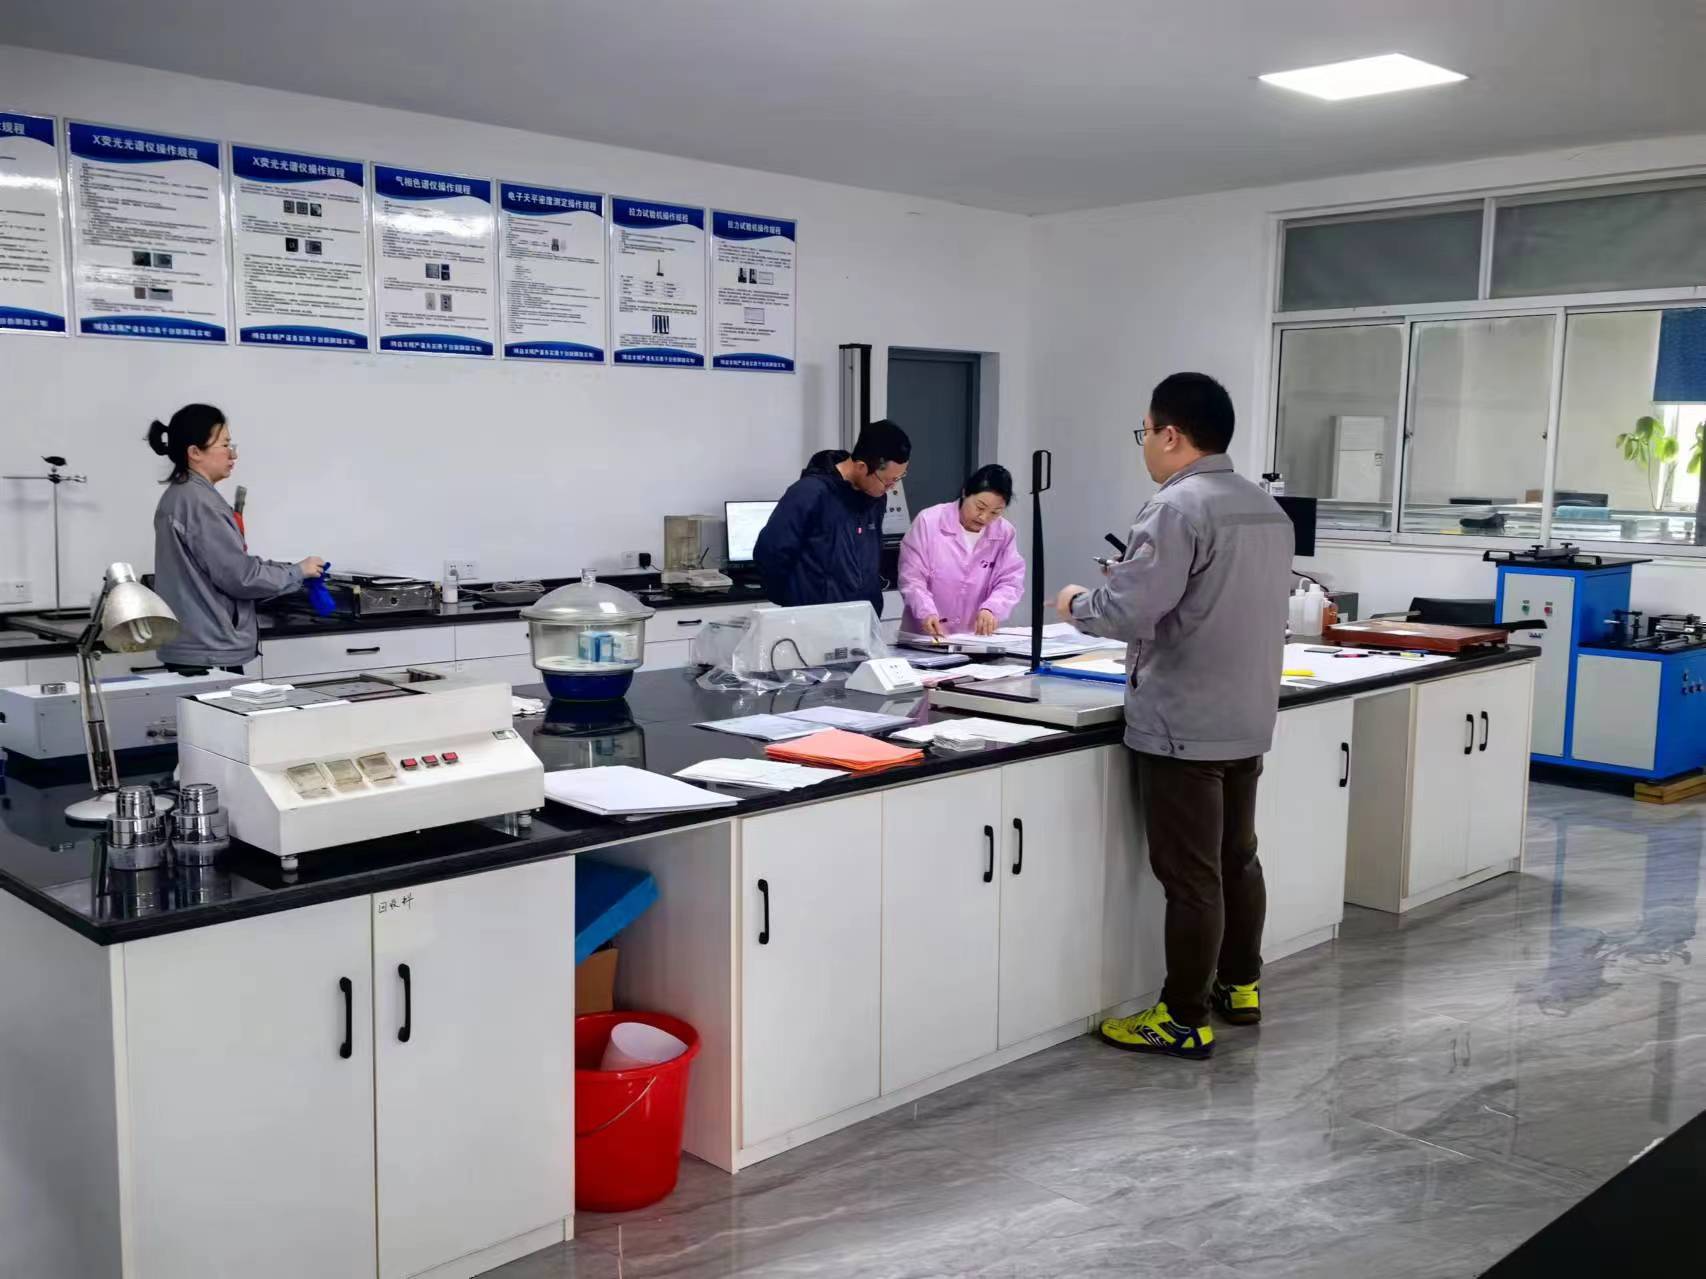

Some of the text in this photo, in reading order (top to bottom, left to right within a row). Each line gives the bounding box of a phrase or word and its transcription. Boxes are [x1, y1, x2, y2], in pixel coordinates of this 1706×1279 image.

[0, 120, 26, 136] 规程
[92, 133, 199, 160] X荧光光谱仪操作规程
[252, 156, 346, 179] X荧光光谱仪操作规程
[395, 175, 472, 195] 气相色谱仪操作规程
